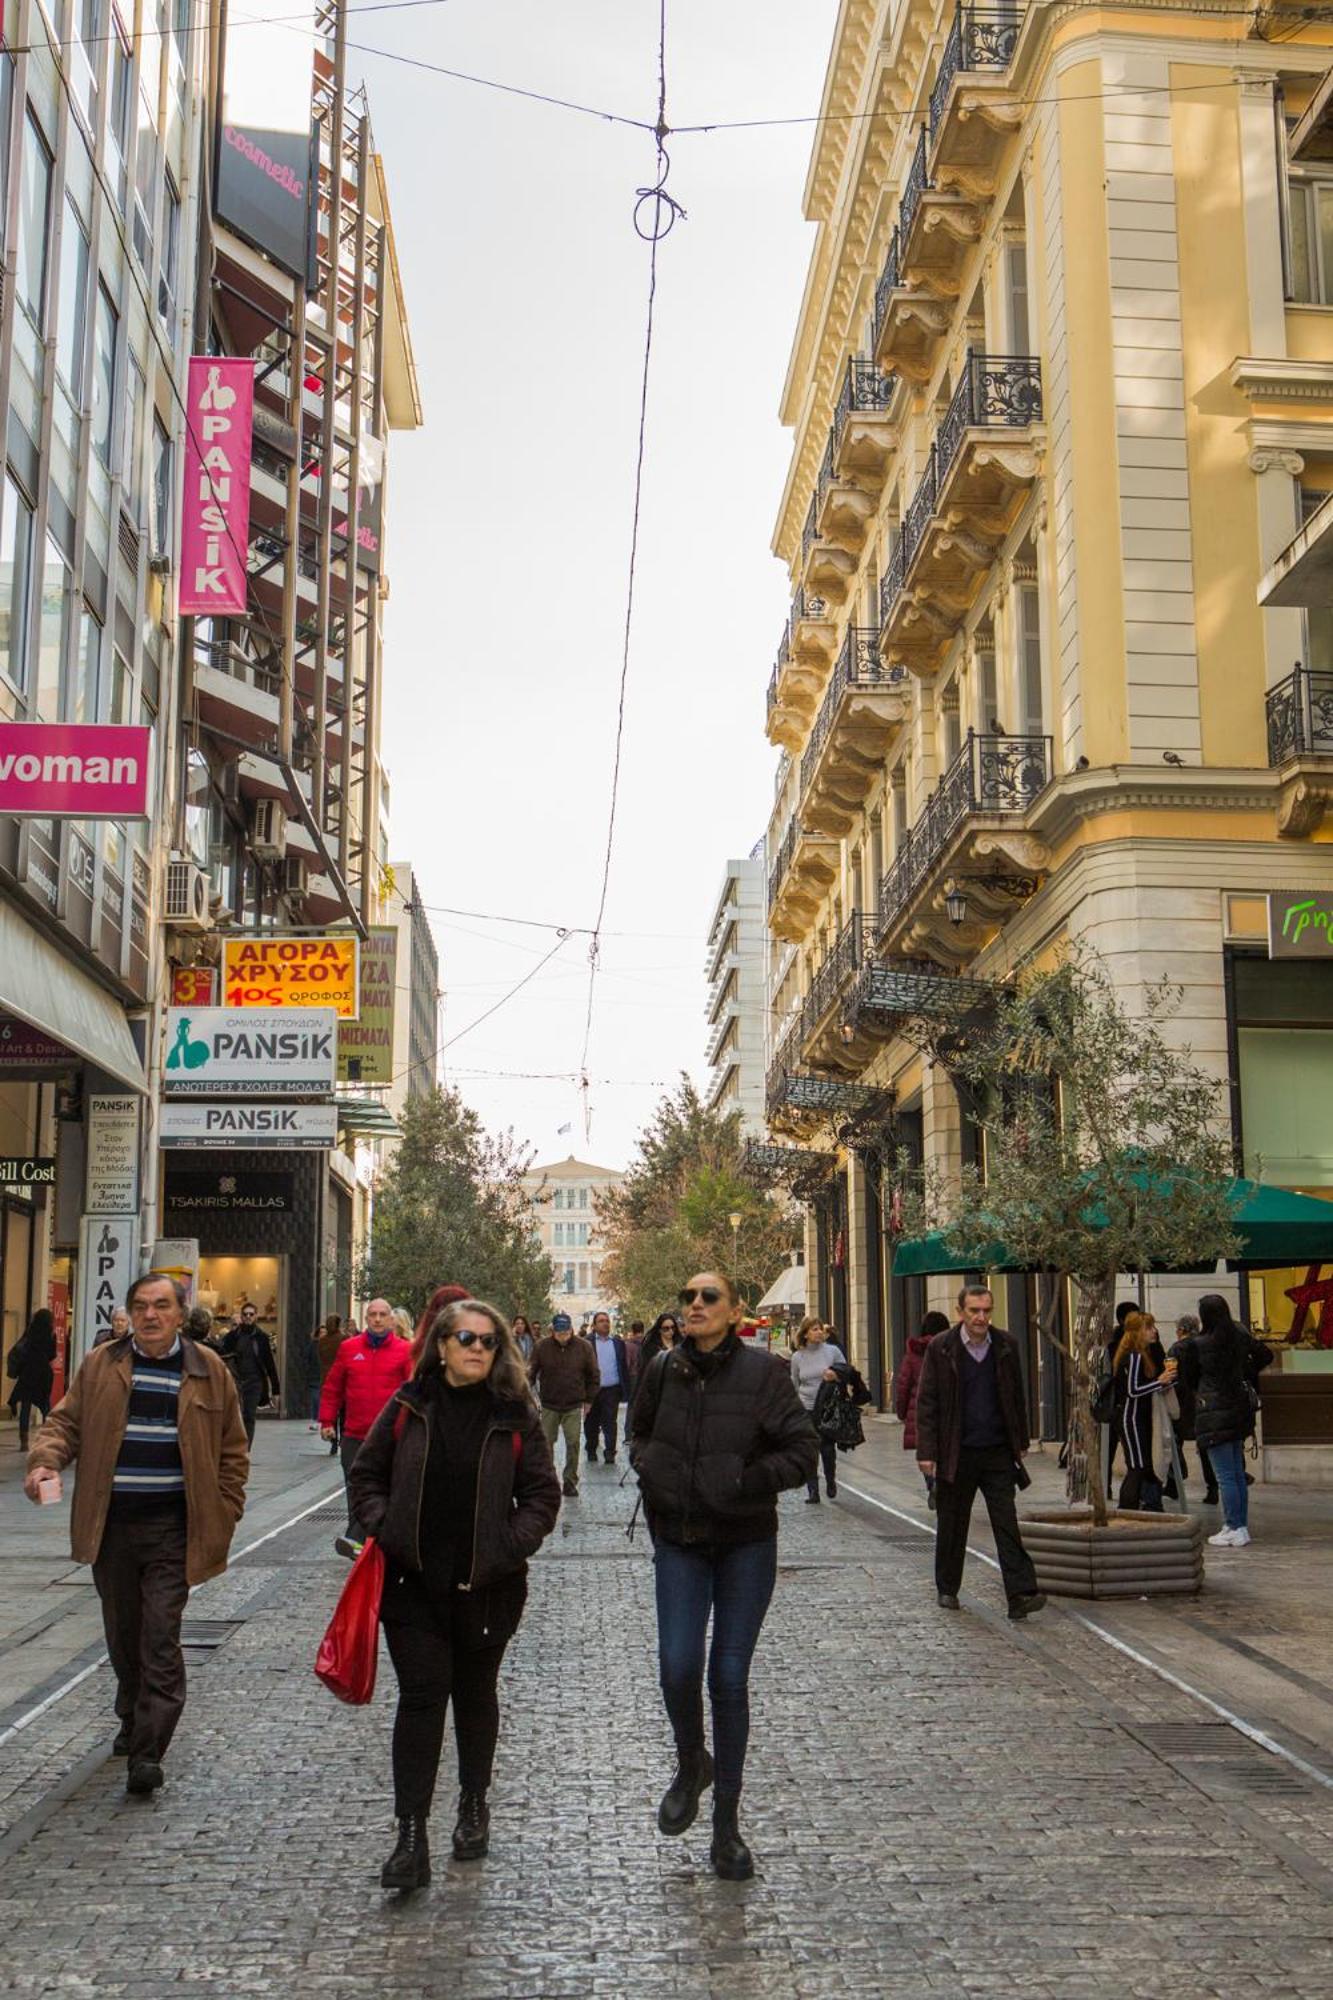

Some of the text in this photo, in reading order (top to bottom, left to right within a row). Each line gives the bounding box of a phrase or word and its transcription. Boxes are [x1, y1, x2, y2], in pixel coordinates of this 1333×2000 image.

[239, 943, 339, 962] ΑΓΟΡΑ
[228, 964, 349, 982] ΧΡΥΣΟΥ
[0, 1162, 55, 1181] ill Cost
[170, 1196, 285, 1207] TSAKIRIS MALLAS
